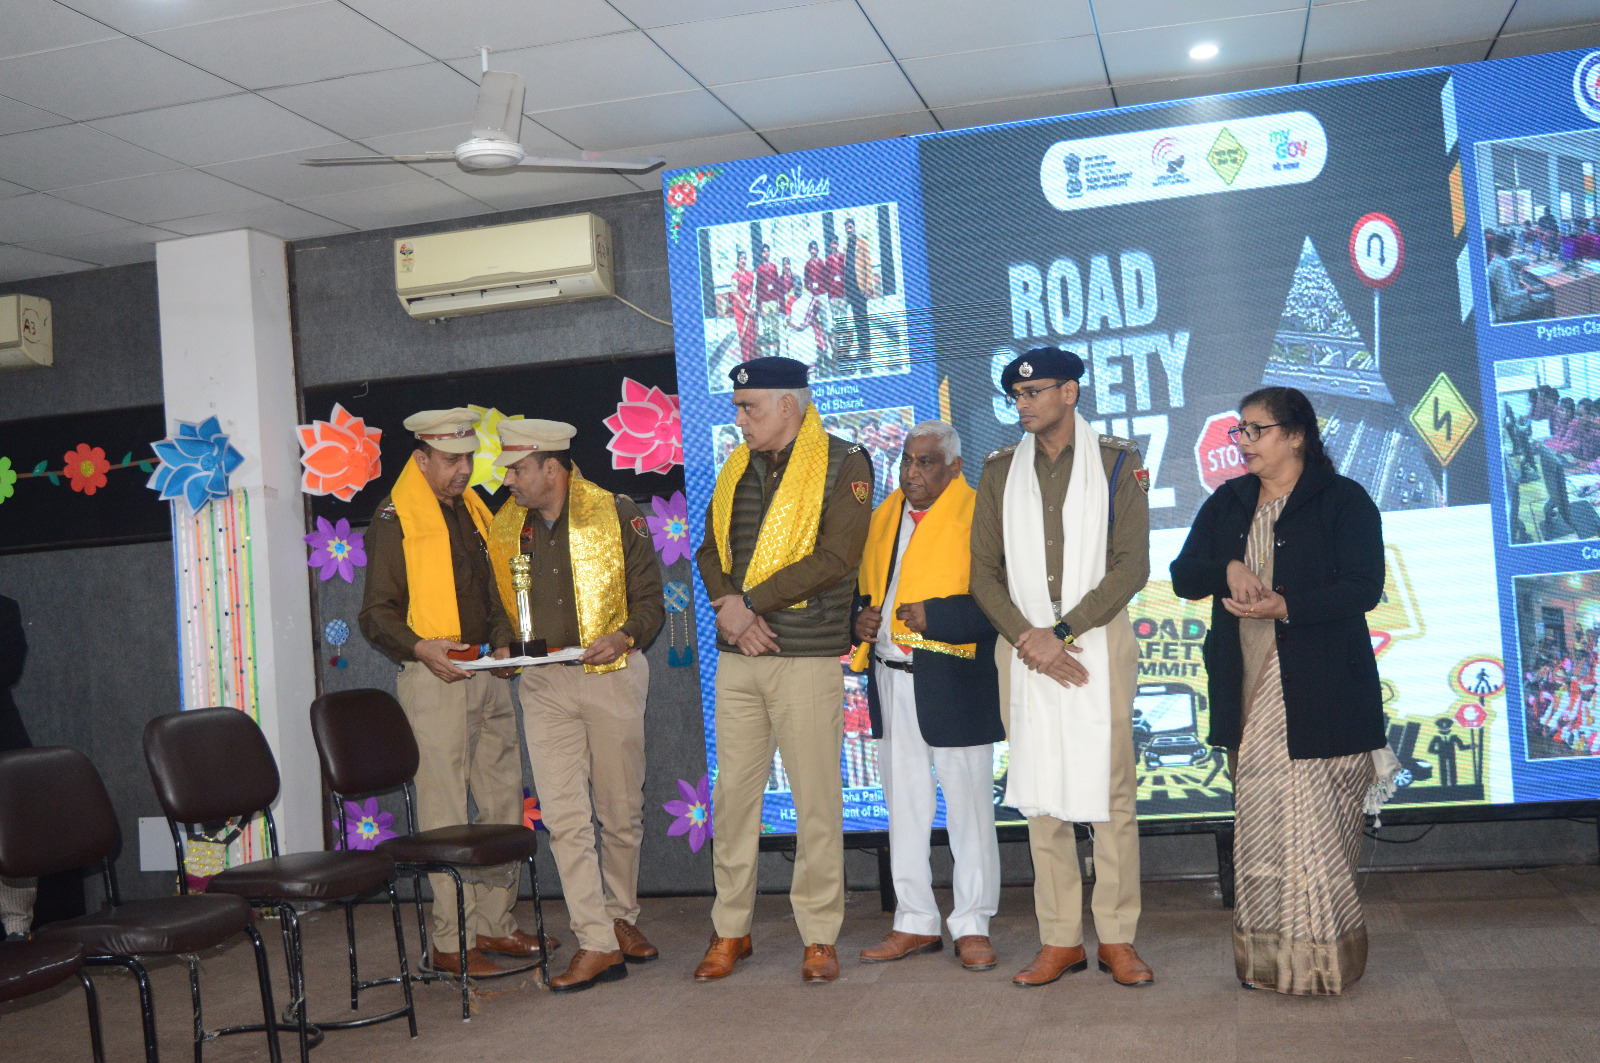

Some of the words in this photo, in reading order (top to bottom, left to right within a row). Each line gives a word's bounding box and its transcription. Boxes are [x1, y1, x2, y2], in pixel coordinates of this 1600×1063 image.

[1275, 139, 1308, 160] GOV
[1008, 250, 1158, 339] ROAD
[23, 318, 37, 336] A3
[1536, 323, 1580, 341] Python
[825, 384, 859, 396] Murmu
[820, 400, 831, 411] of
[1132, 617, 1207, 641] OAD
[1138, 662, 1201, 676] MMIT
[861, 805, 872, 818] of
